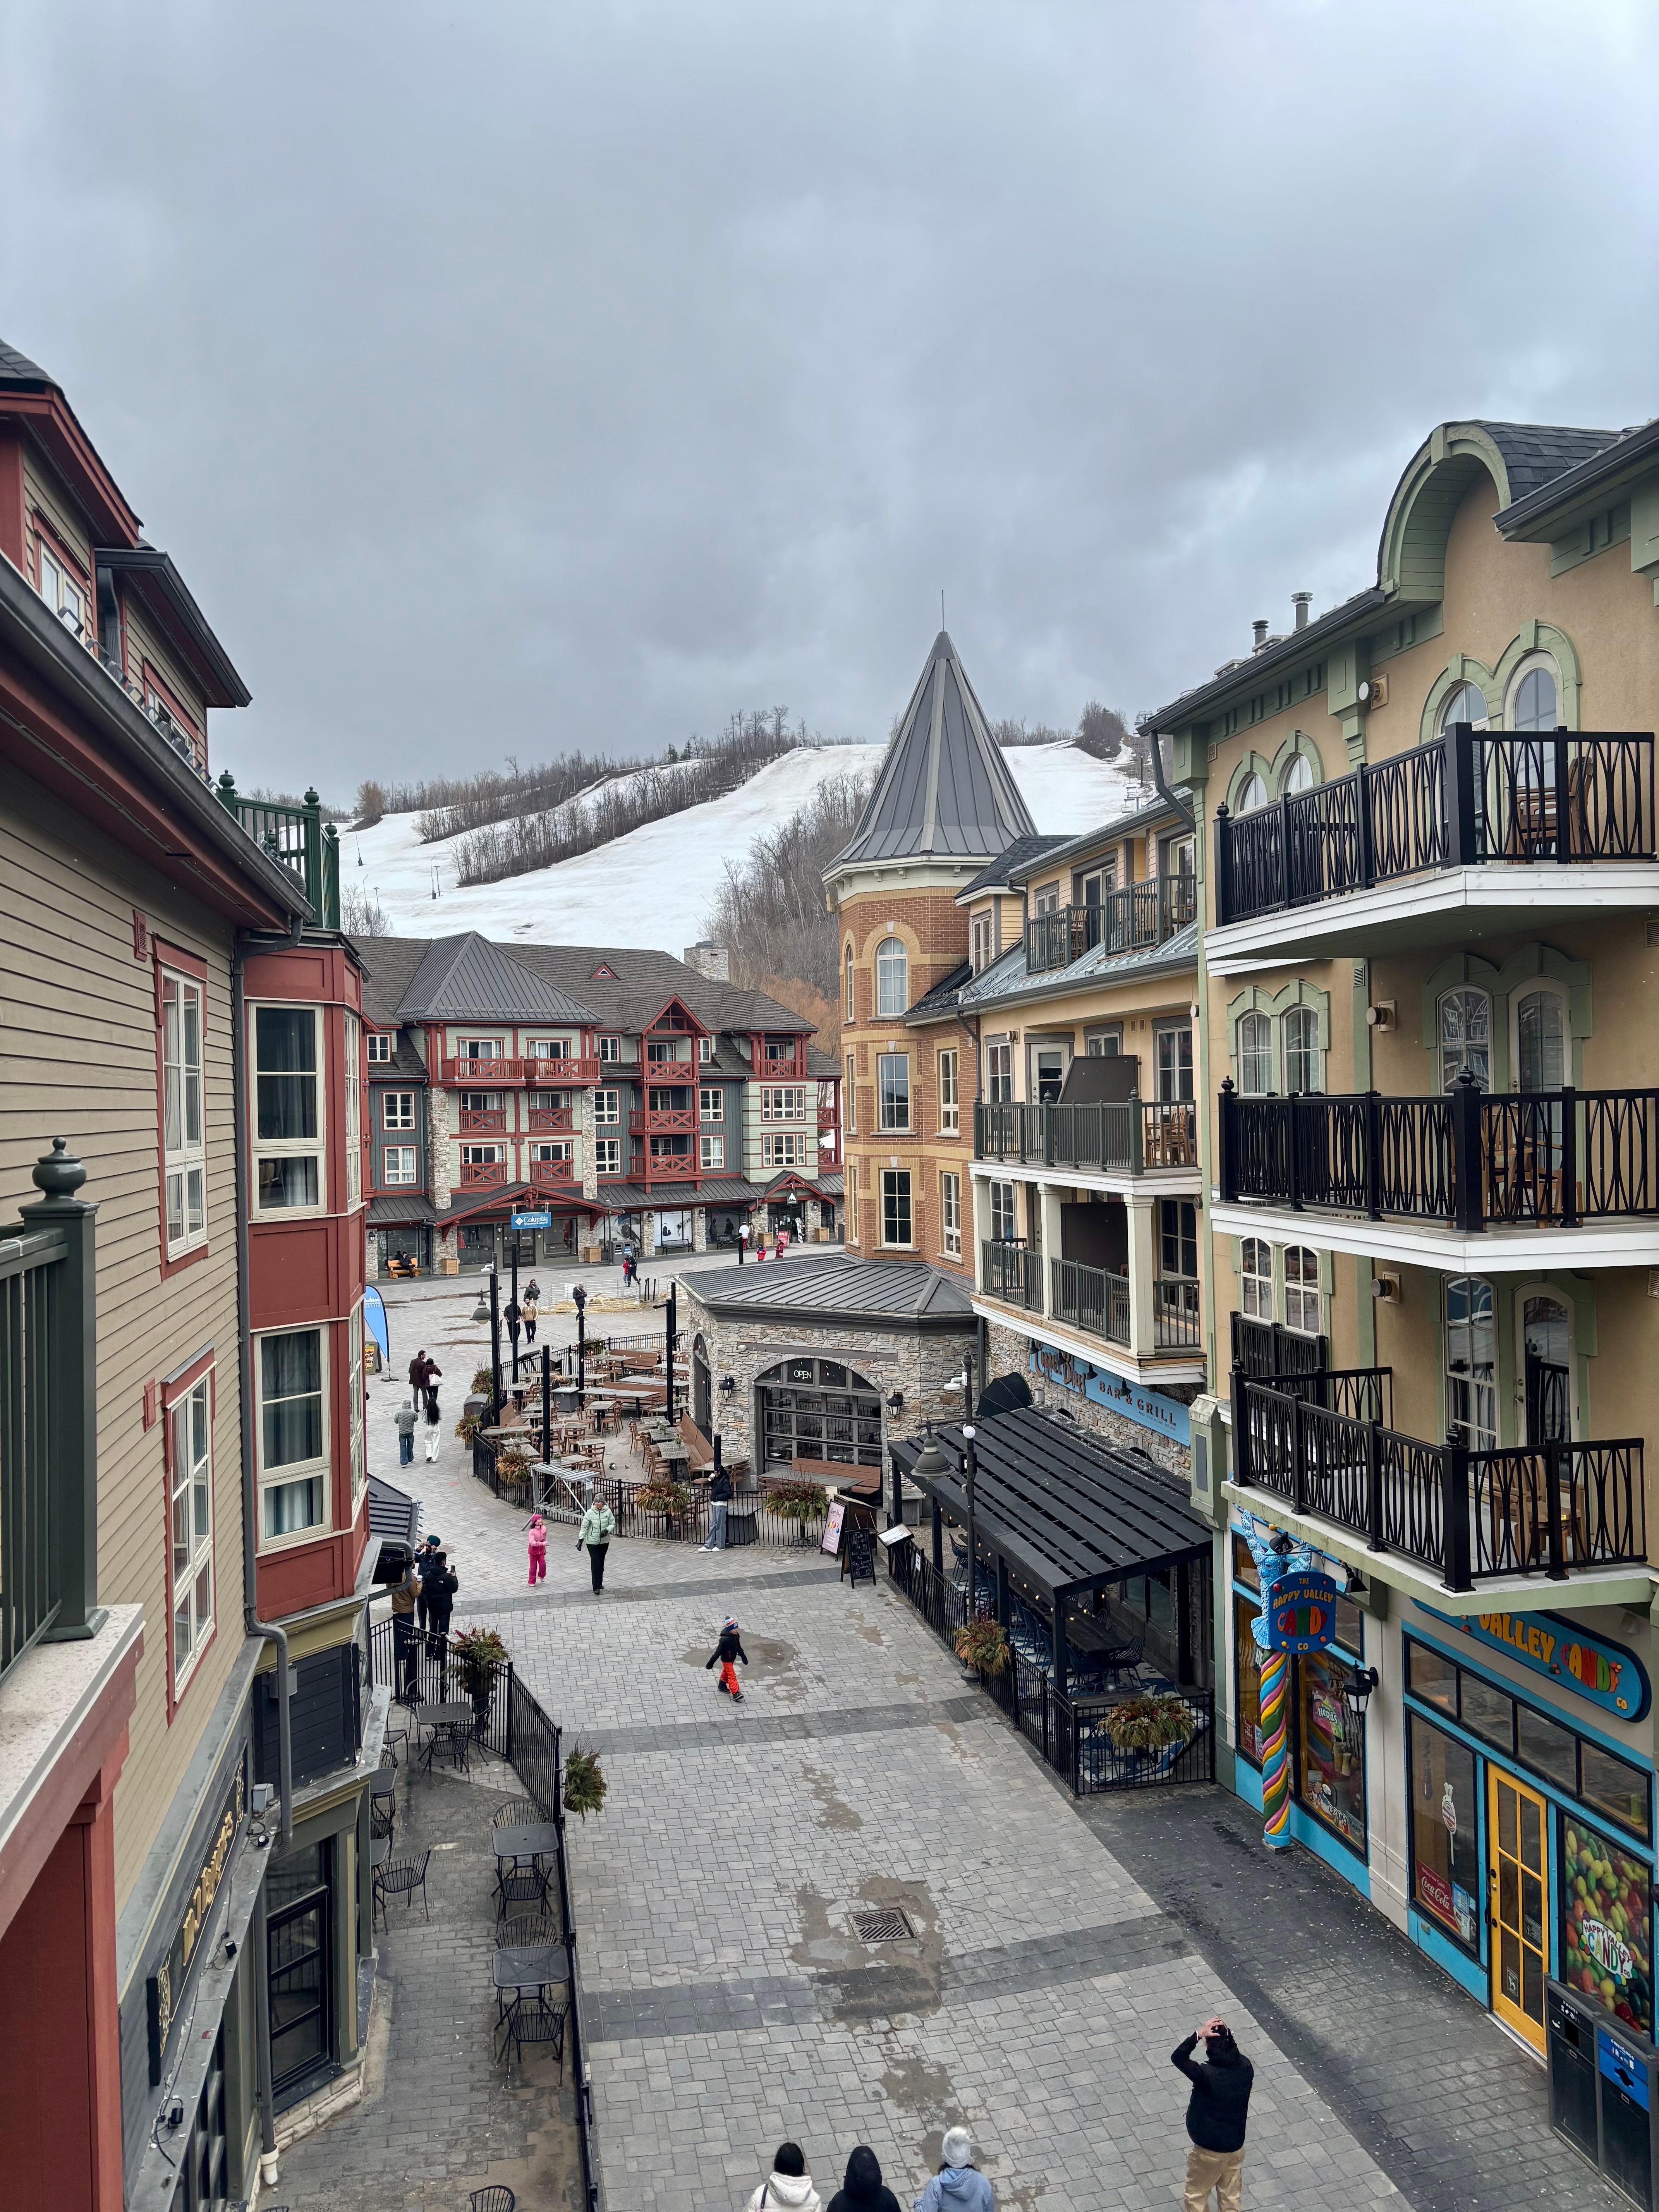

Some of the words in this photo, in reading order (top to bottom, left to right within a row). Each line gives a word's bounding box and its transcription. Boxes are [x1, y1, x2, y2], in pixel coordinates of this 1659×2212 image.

[794, 1370, 812, 1379] OPEN
[1099, 1381, 1120, 1400] BAR
[1137, 1399, 1176, 1426] GRILL
[1273, 1590, 1300, 1610] HAPPY
[1304, 1589, 1333, 1603] VALLEY
[1277, 1606, 1328, 1636] CANDY
[1479, 1613, 1555, 1663] VALLEY
[1561, 1643, 1619, 1693] CANDY
[1616, 1697, 1628, 1710] CO
[1422, 1877, 1450, 1910] Coca-Cola
[1584, 1924, 1605, 1937] HAPPY
[1606, 1932, 1632, 1963] VALLEY
[1588, 1932, 1626, 1973] CANDY
